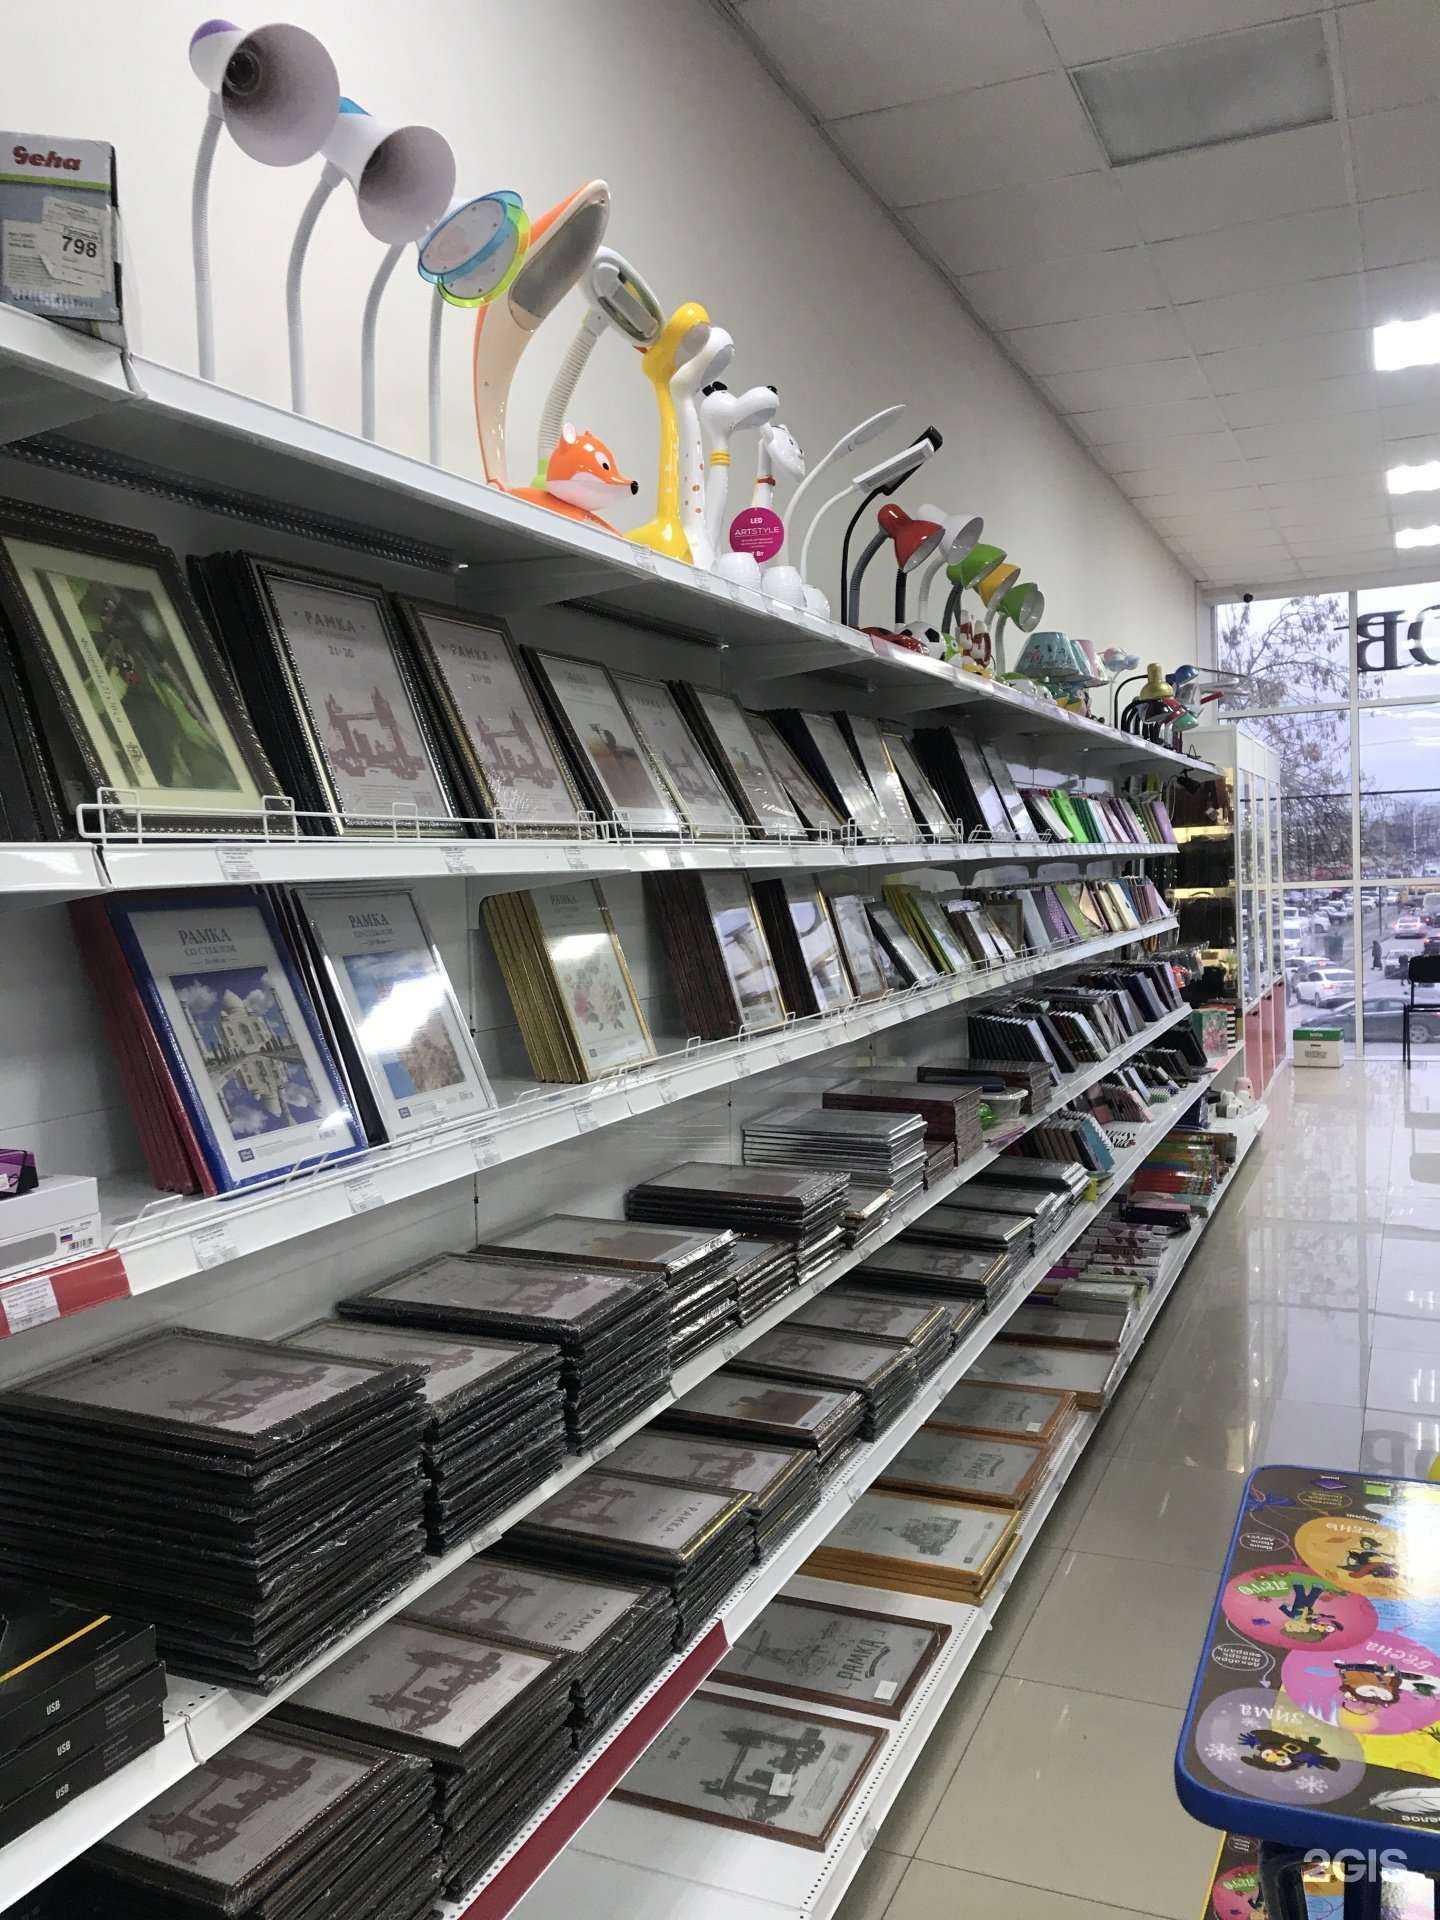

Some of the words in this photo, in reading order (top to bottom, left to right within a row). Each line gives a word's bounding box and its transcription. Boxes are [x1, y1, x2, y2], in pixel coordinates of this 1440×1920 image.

[62, 235, 97, 258] 798
[735, 526, 780, 536] ARTSTYLE
[303, 610, 356, 632] РАМКА
[348, 912, 390, 928] РАМКА
[178, 927, 232, 946] РАМКА
[559, 1608, 602, 1641] РАМКА
[836, 1639, 888, 1682] РАМКА
[46, 1700, 60, 1715] USB
[57, 1740, 71, 1756] USB
[55, 1783, 69, 1799] USB
